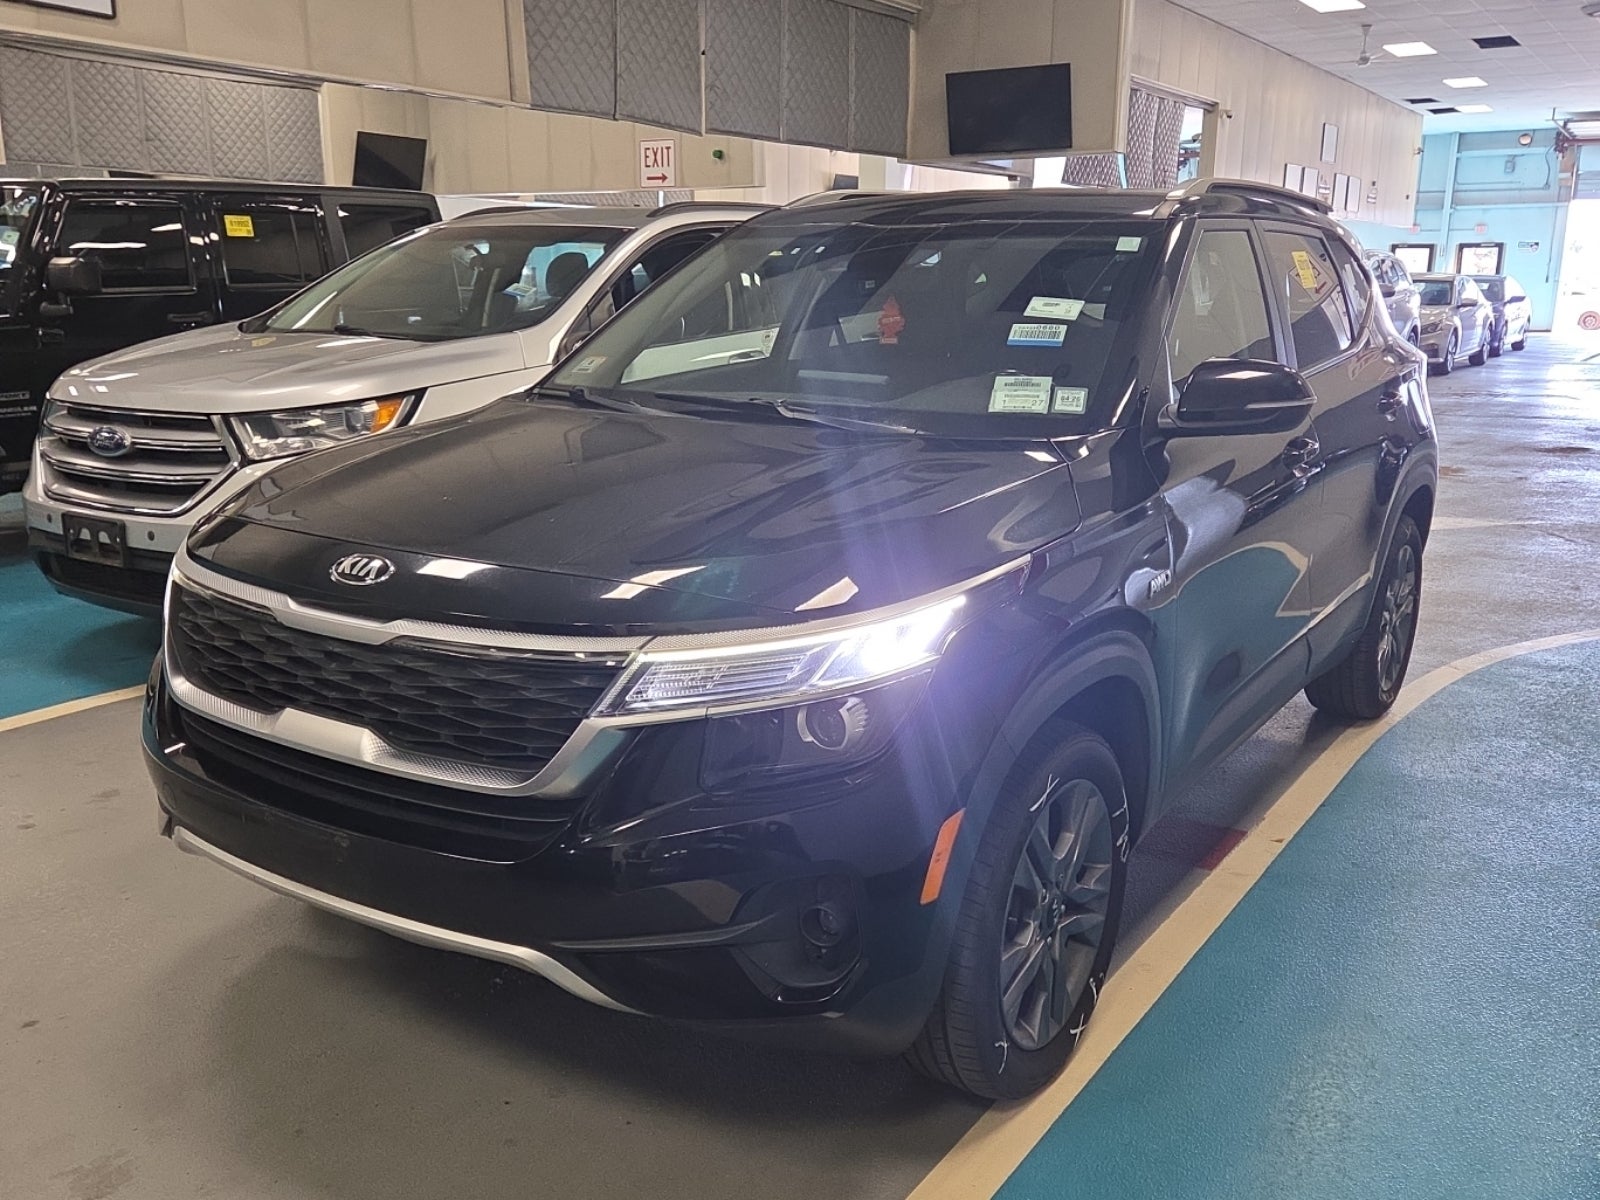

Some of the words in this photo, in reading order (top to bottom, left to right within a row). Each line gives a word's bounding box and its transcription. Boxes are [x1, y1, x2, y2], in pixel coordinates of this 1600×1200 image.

[644, 146, 672, 168] EXIT
[337, 557, 384, 580] KIA
[1150, 569, 1172, 598] AWD
